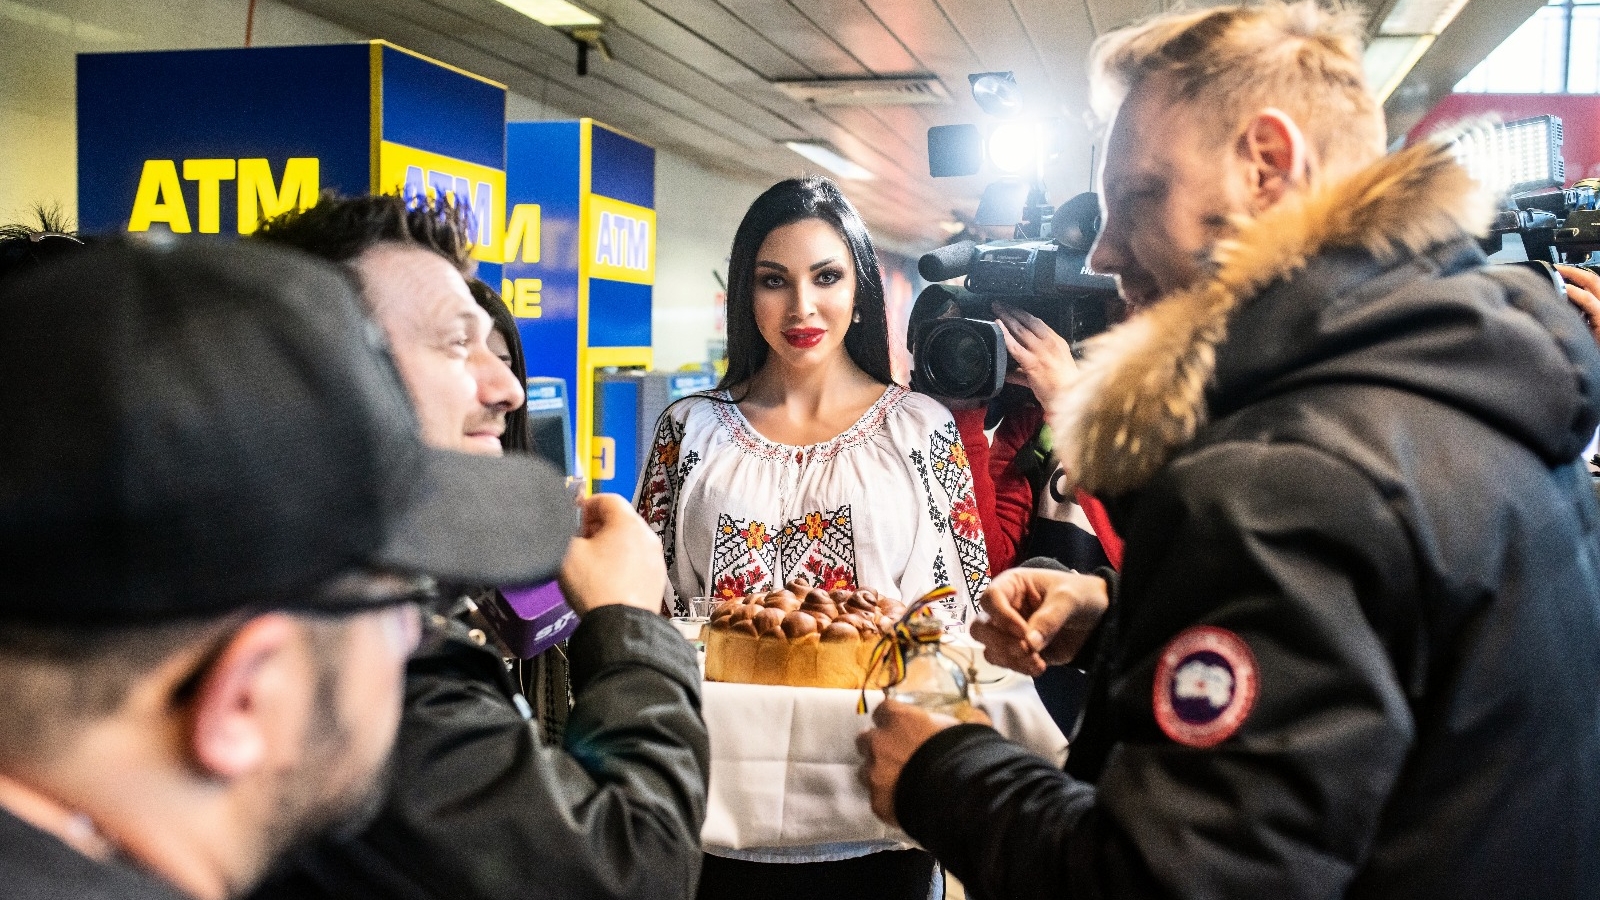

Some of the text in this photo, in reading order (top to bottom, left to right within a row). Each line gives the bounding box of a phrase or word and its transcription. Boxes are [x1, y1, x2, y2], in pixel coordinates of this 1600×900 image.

[127, 157, 320, 234] ATM
[403, 165, 492, 247] ATM
[503, 203, 541, 264] M
[597, 211, 648, 270] ATM
